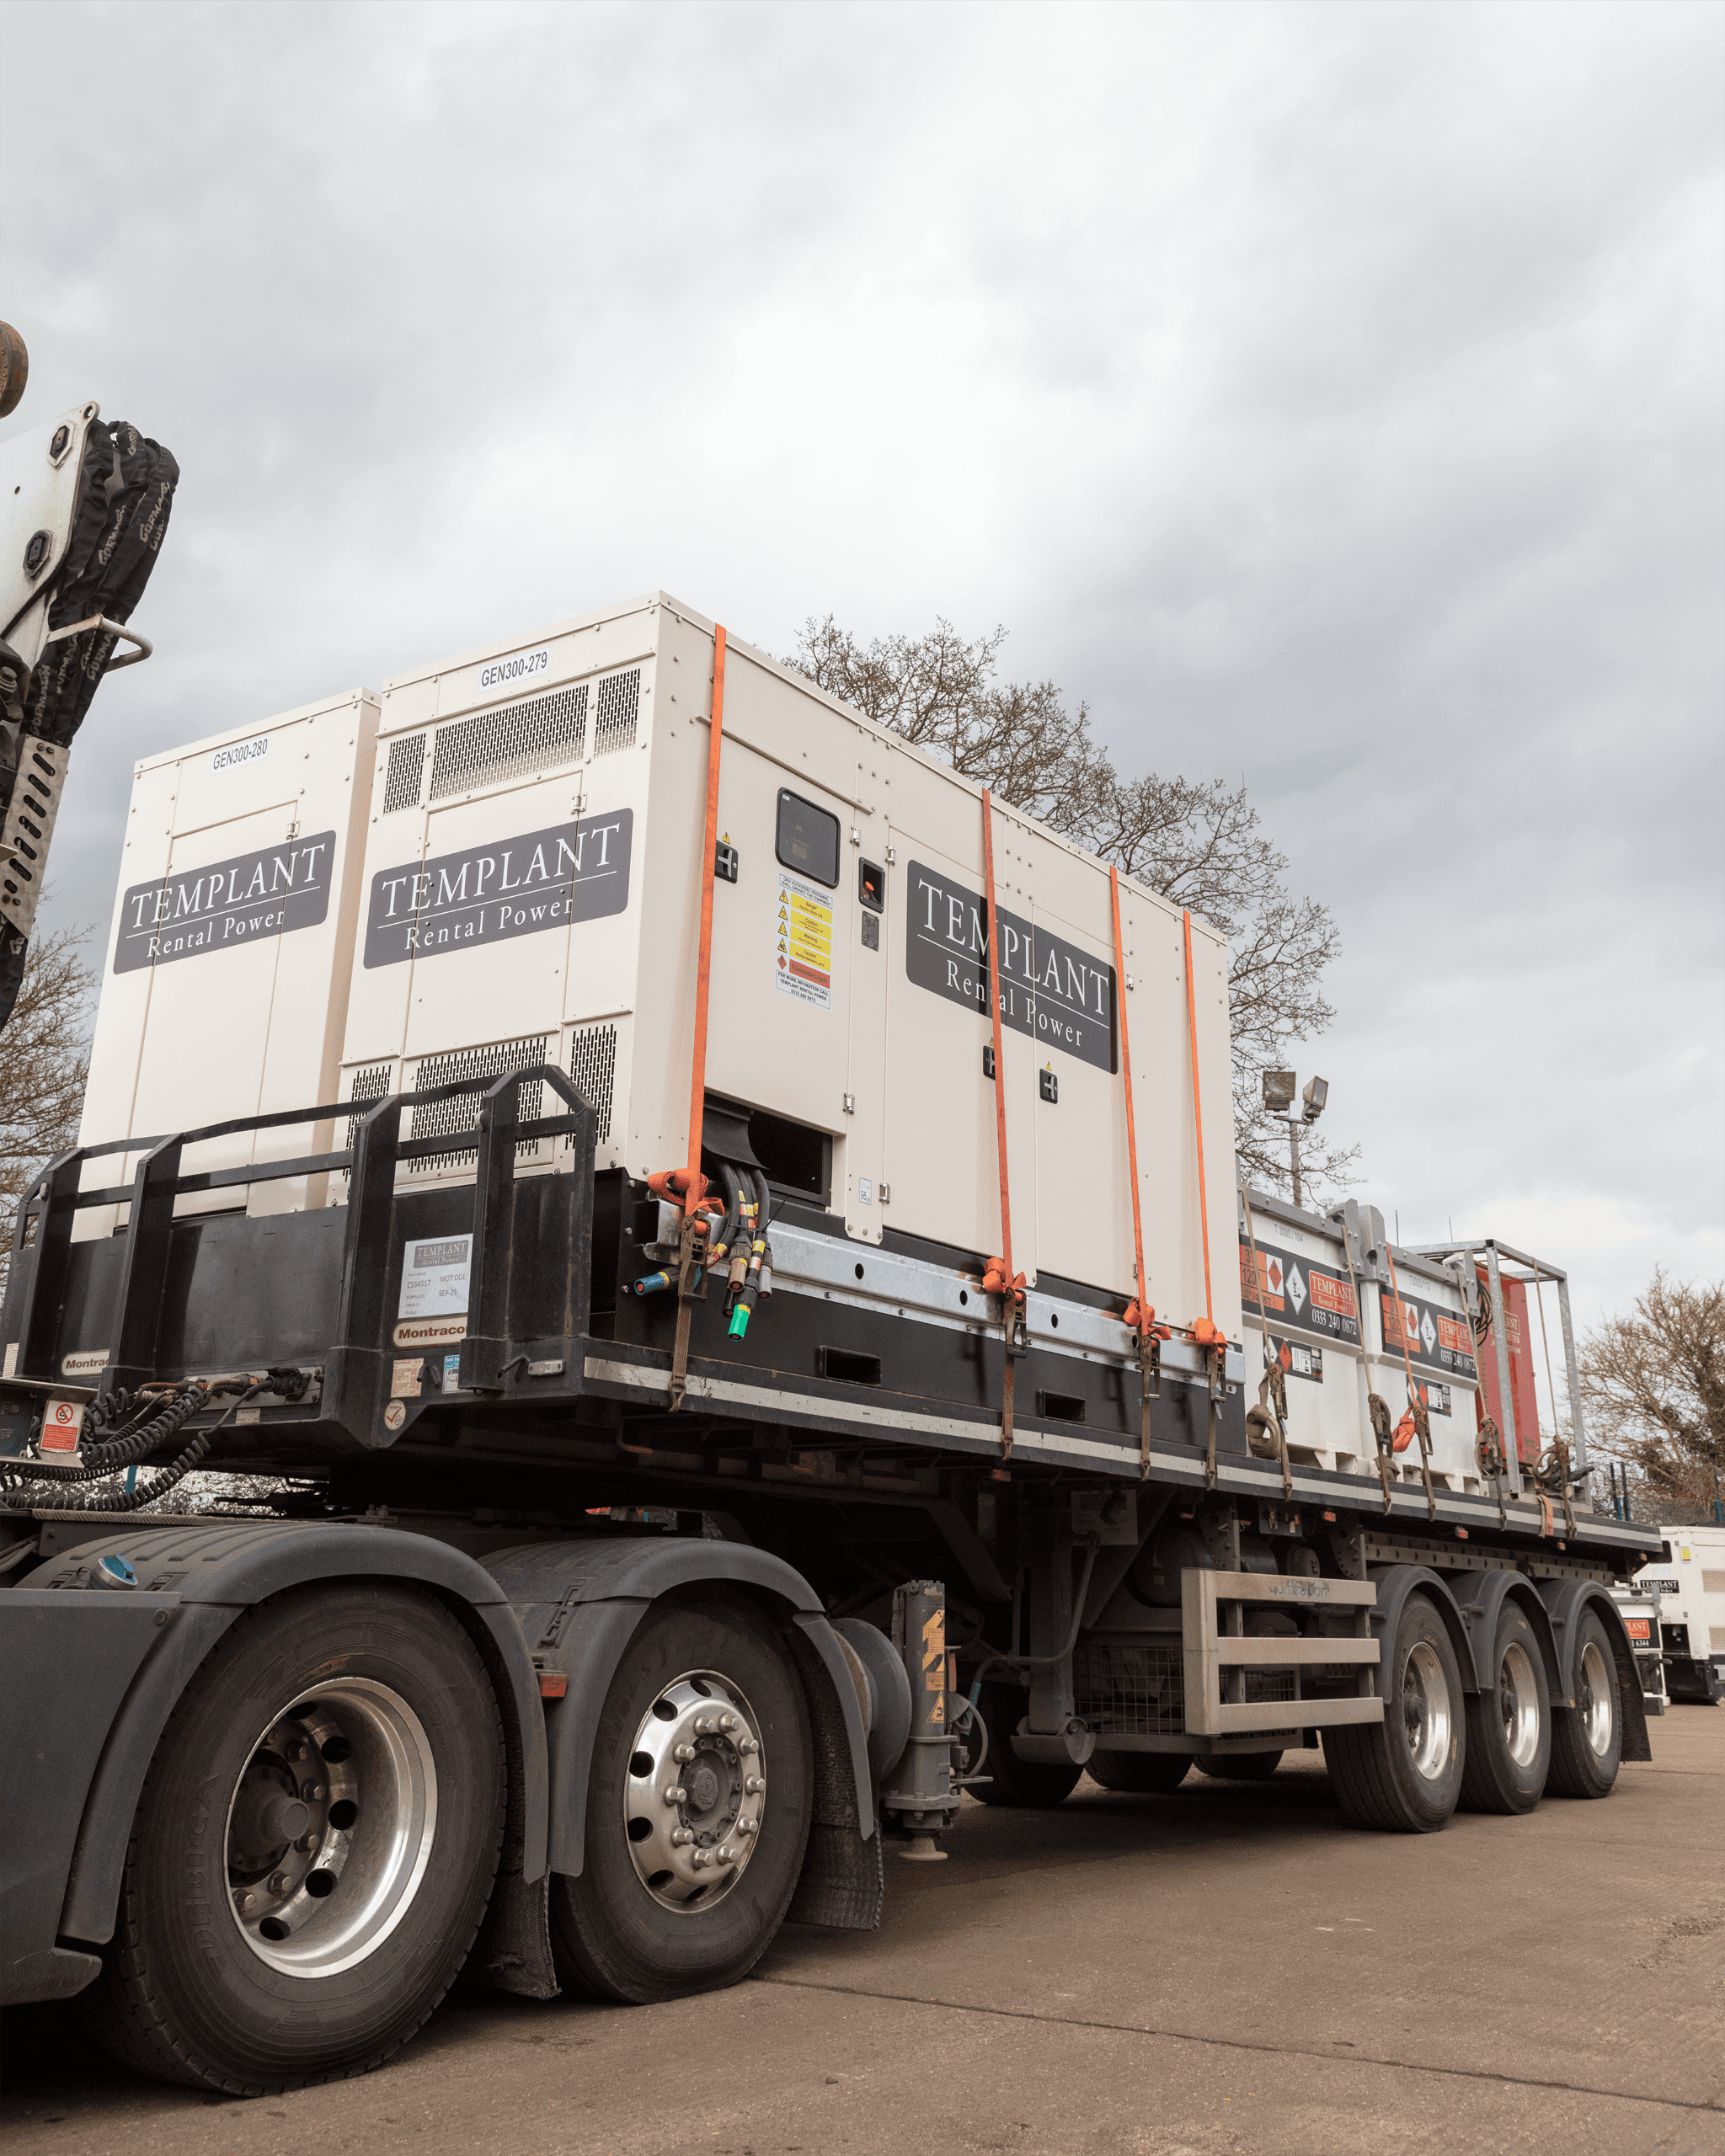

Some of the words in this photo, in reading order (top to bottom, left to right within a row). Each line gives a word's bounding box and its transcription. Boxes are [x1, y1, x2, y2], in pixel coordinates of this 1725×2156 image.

[480, 650, 548, 688] GEN300-279
[212, 738, 269, 771] GEN300-280
[381, 822, 621, 918] TEMPLANT
[131, 843, 326, 928] TEMPLANT
[147, 921, 213, 958] Rental
[222, 910, 285, 939] Power
[404, 910, 484, 951] Rental
[499, 898, 573, 930] Power
[918, 878, 1108, 1016] TEMPLANT
[780, 978, 799, 990] TEMPLANT
[814, 992, 827, 1001] POWER
[786, 974, 797, 984] MORE
[946, 959, 1015, 1017] Renal
[1025, 997, 1082, 1046] Power
[417, 1242, 467, 1257] TEMPLANT
[440, 1274, 453, 1283] MOT
[455, 1273, 468, 1281] DUE:
[1311, 1275, 1353, 1302] TEMPLANT
[438, 1289, 457, 1298] SEP-25
[398, 1326, 467, 1339] Montraco
[1311, 1308, 1327, 1326] 0333
[1328, 1314, 1341, 1331] 240
[1342, 1318, 1357, 1336] 0872
[66, 1358, 109, 1369] Montrac
